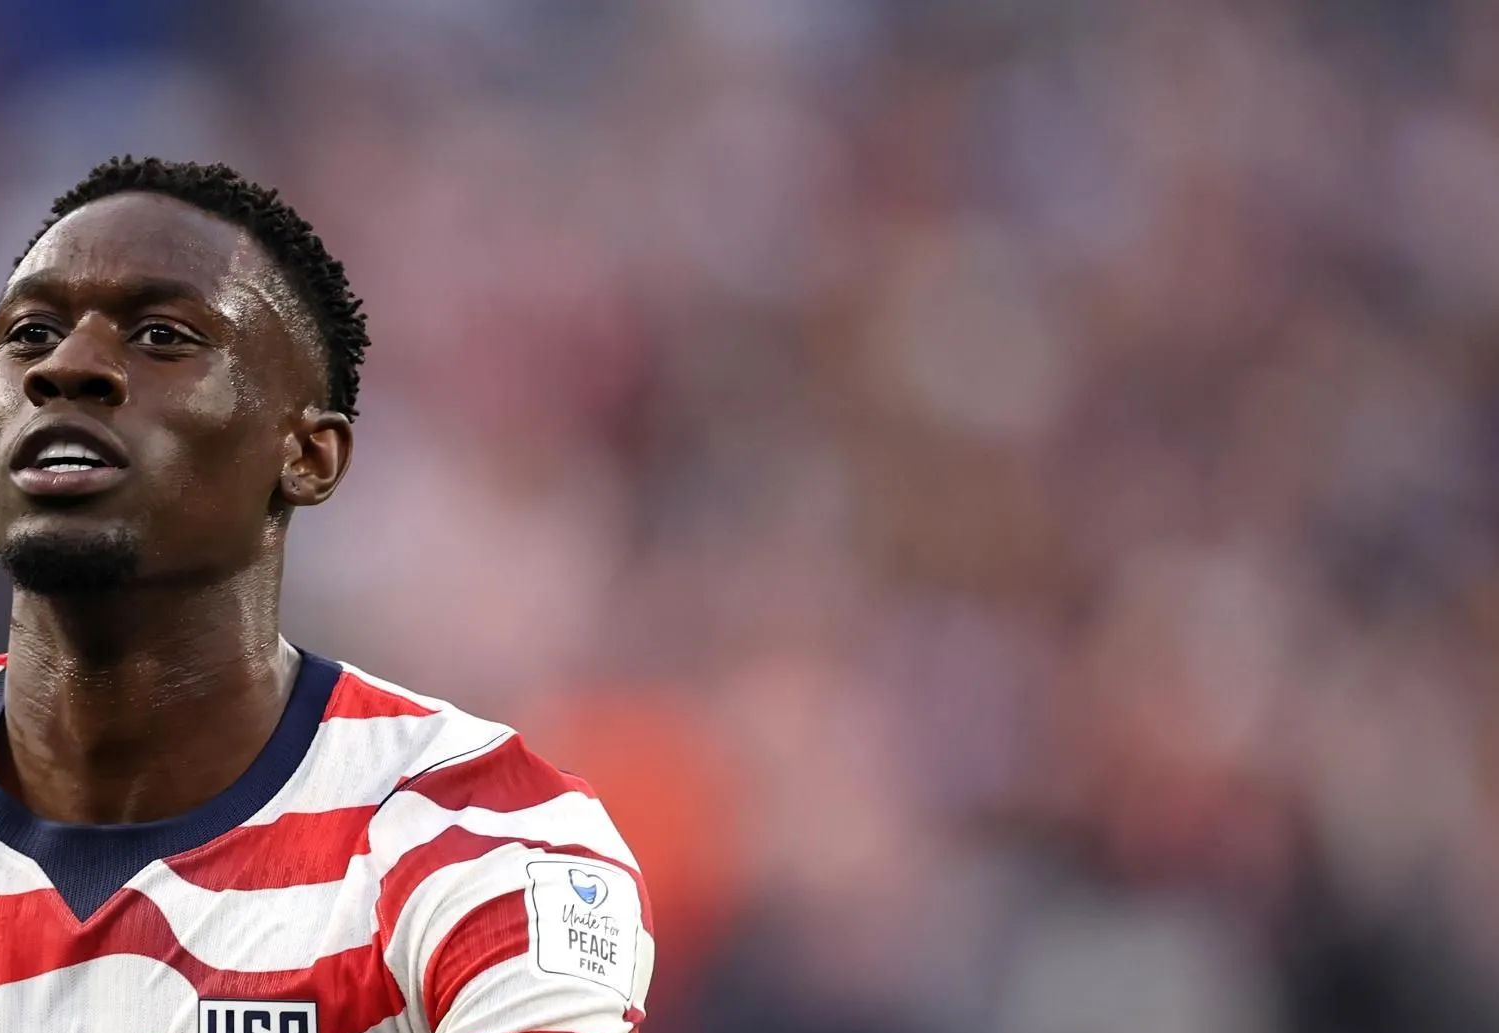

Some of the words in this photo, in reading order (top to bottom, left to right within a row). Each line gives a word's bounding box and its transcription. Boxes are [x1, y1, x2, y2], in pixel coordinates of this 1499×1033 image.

[562, 903, 600, 930] Unite
[601, 915, 620, 937] For
[568, 928, 618, 965] PEACE
[579, 957, 606, 976] FIFA
